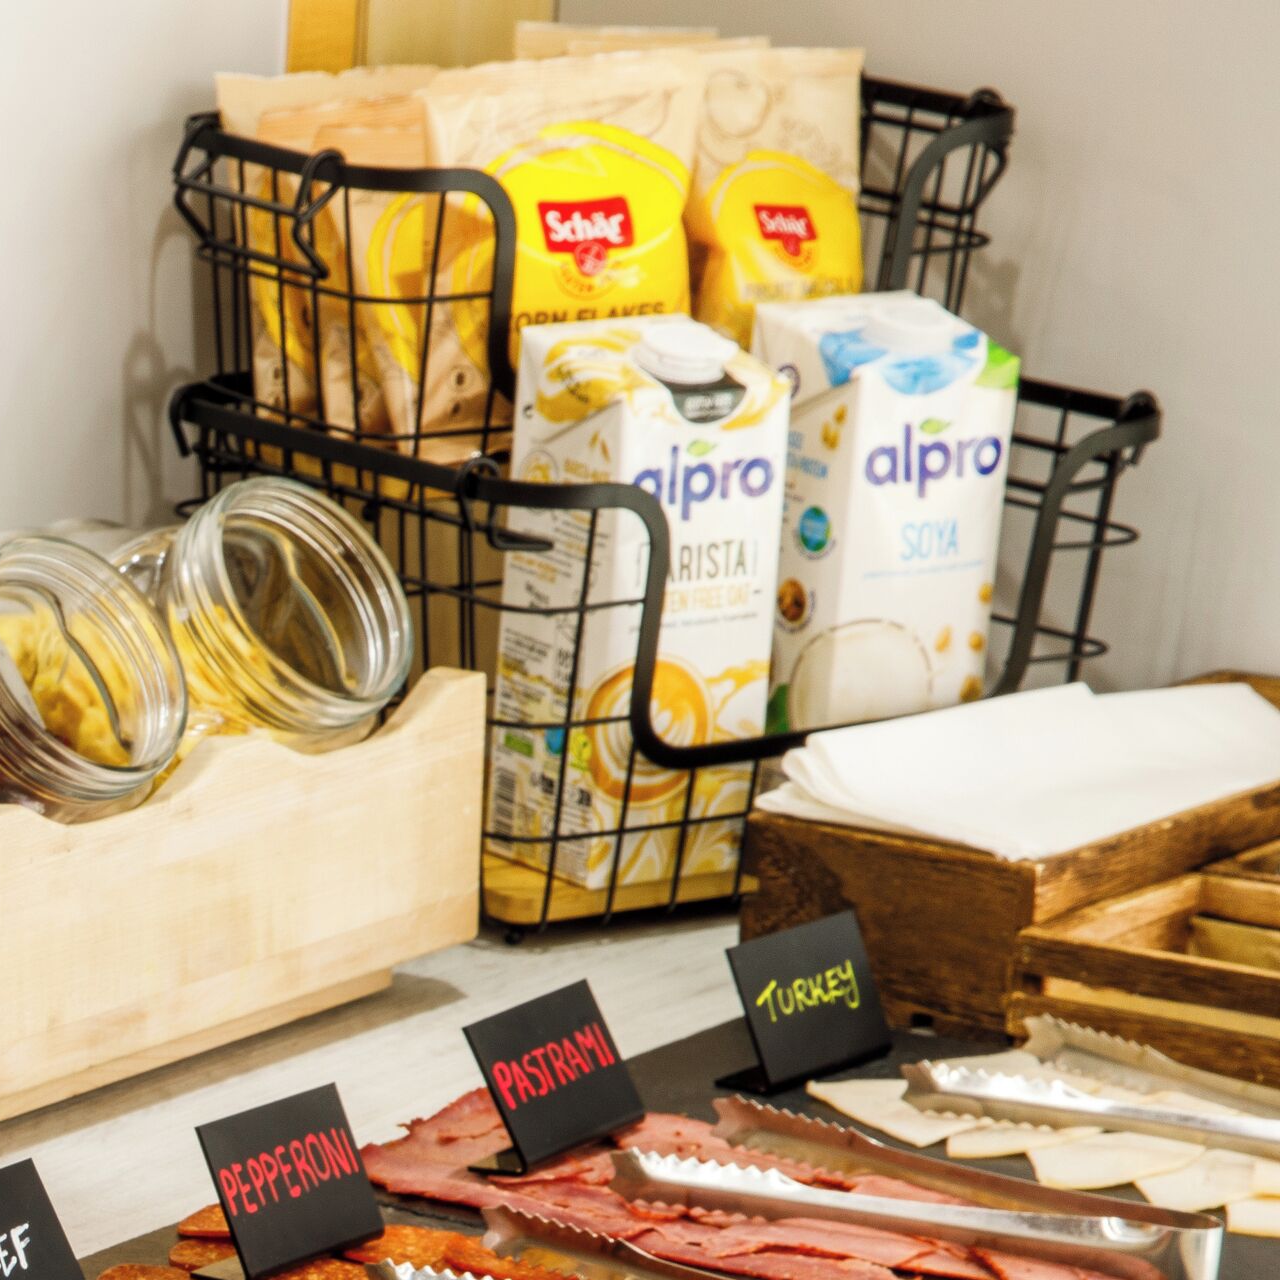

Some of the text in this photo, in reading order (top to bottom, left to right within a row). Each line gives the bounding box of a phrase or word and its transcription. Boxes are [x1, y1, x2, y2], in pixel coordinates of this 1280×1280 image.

[545, 211, 624, 244] Schär
[634, 446, 774, 521] alpro
[865, 424, 1002, 498] alpro
[667, 539, 746, 582] RISTA
[901, 519, 959, 561] SOYA
[756, 959, 859, 1023] TURKEY
[492, 1022, 616, 1110] PASTRAMI
[219, 1128, 359, 1216] PEPPERONI
